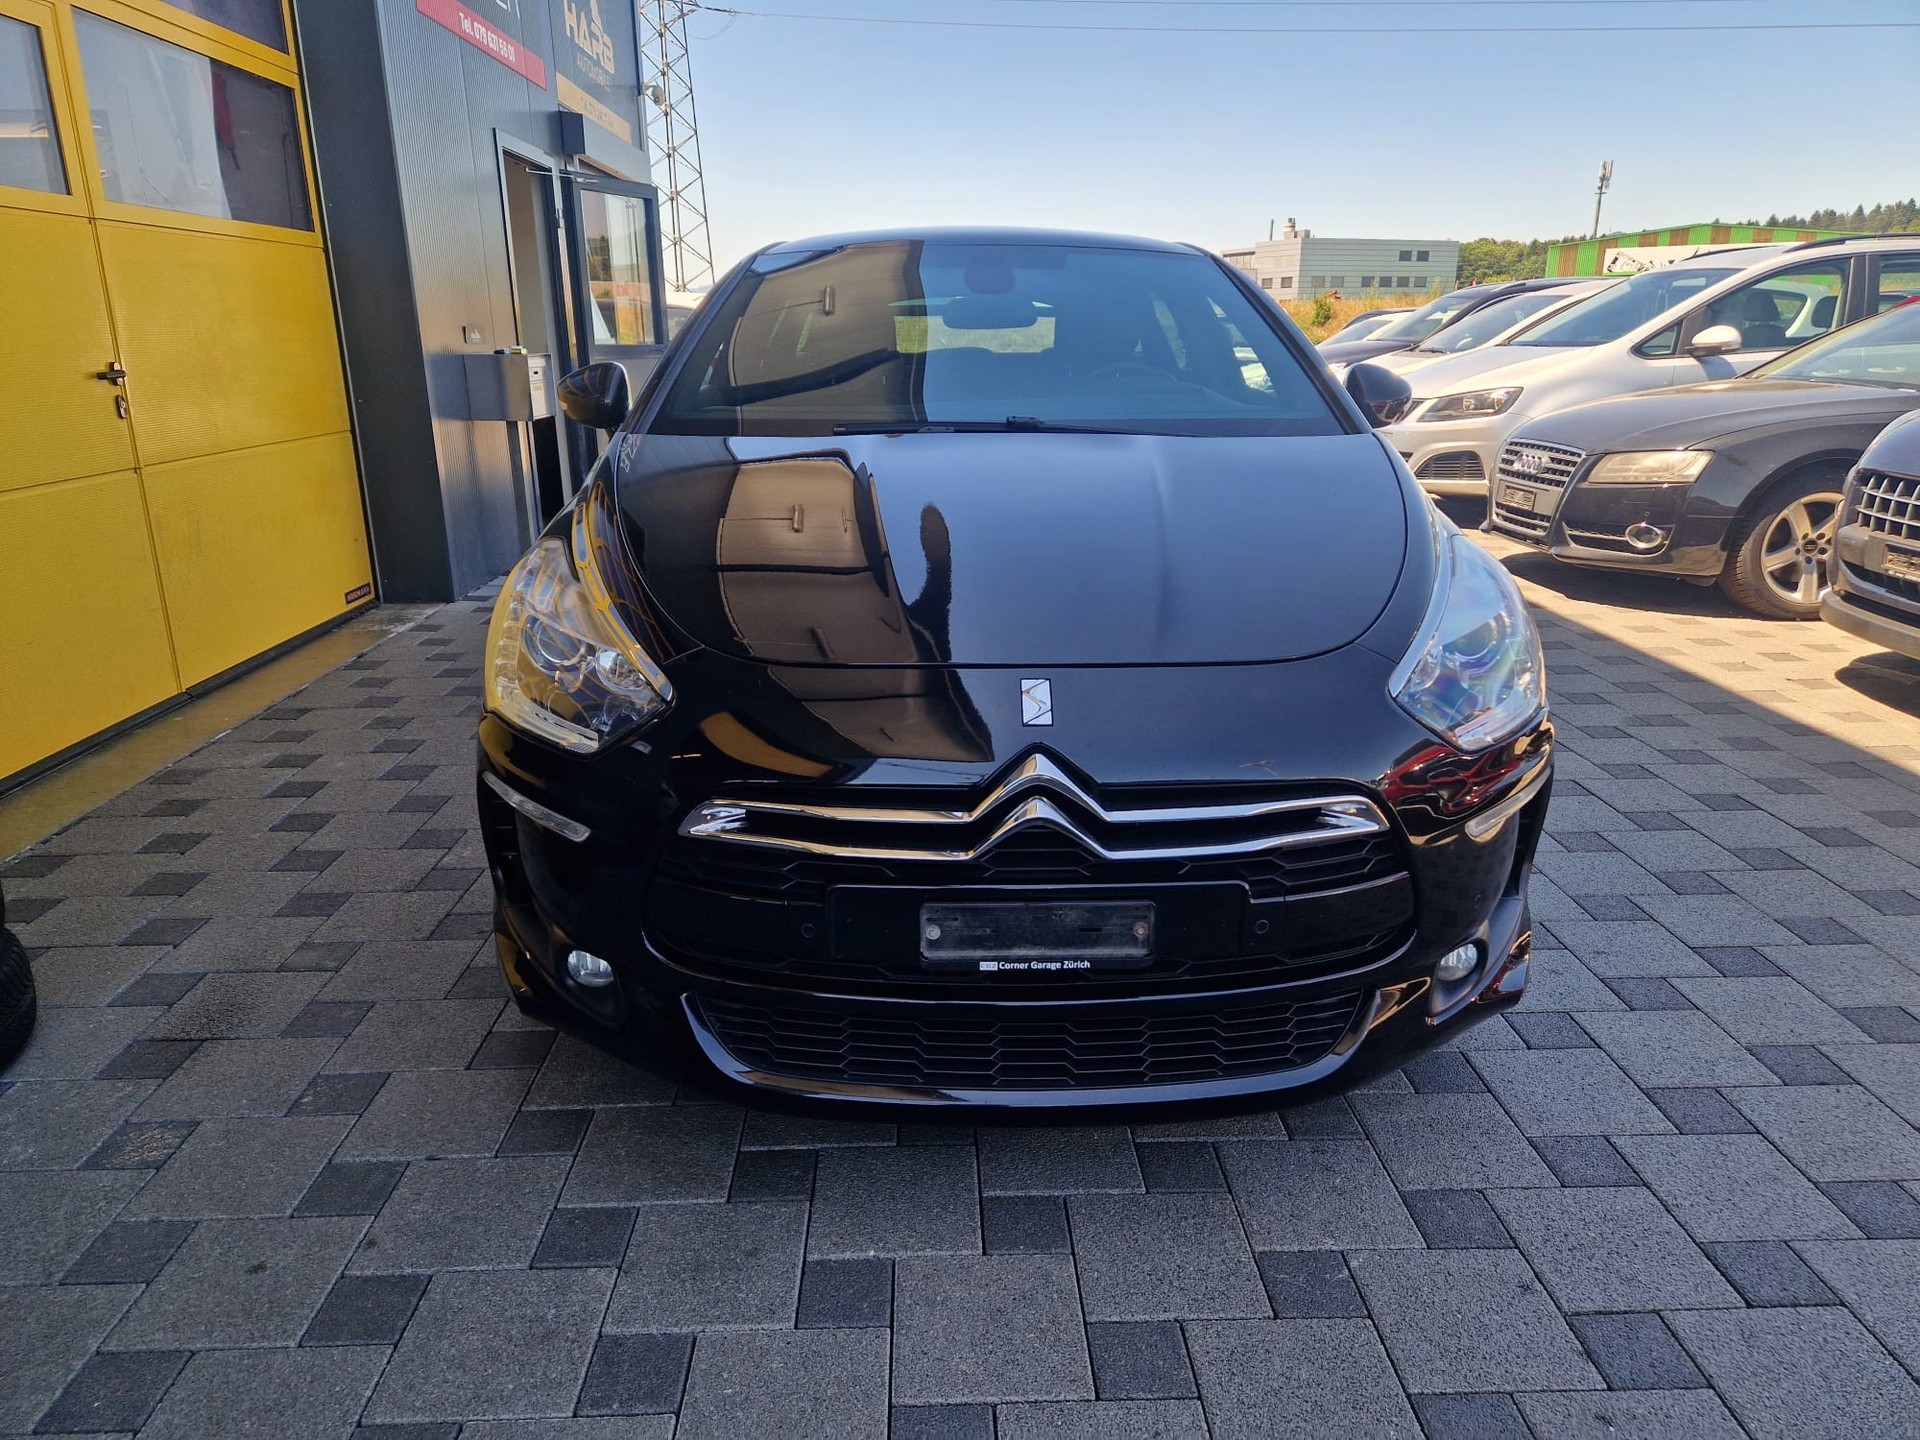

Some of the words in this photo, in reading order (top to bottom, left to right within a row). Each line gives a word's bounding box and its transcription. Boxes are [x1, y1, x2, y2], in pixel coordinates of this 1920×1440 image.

[459, 12, 474, 36] Tel.
[473, 21, 488, 46] 079
[999, 961, 1029, 970] Corner
[1030, 961, 1061, 971] Garage
[1063, 960, 1091, 969] Zürich
